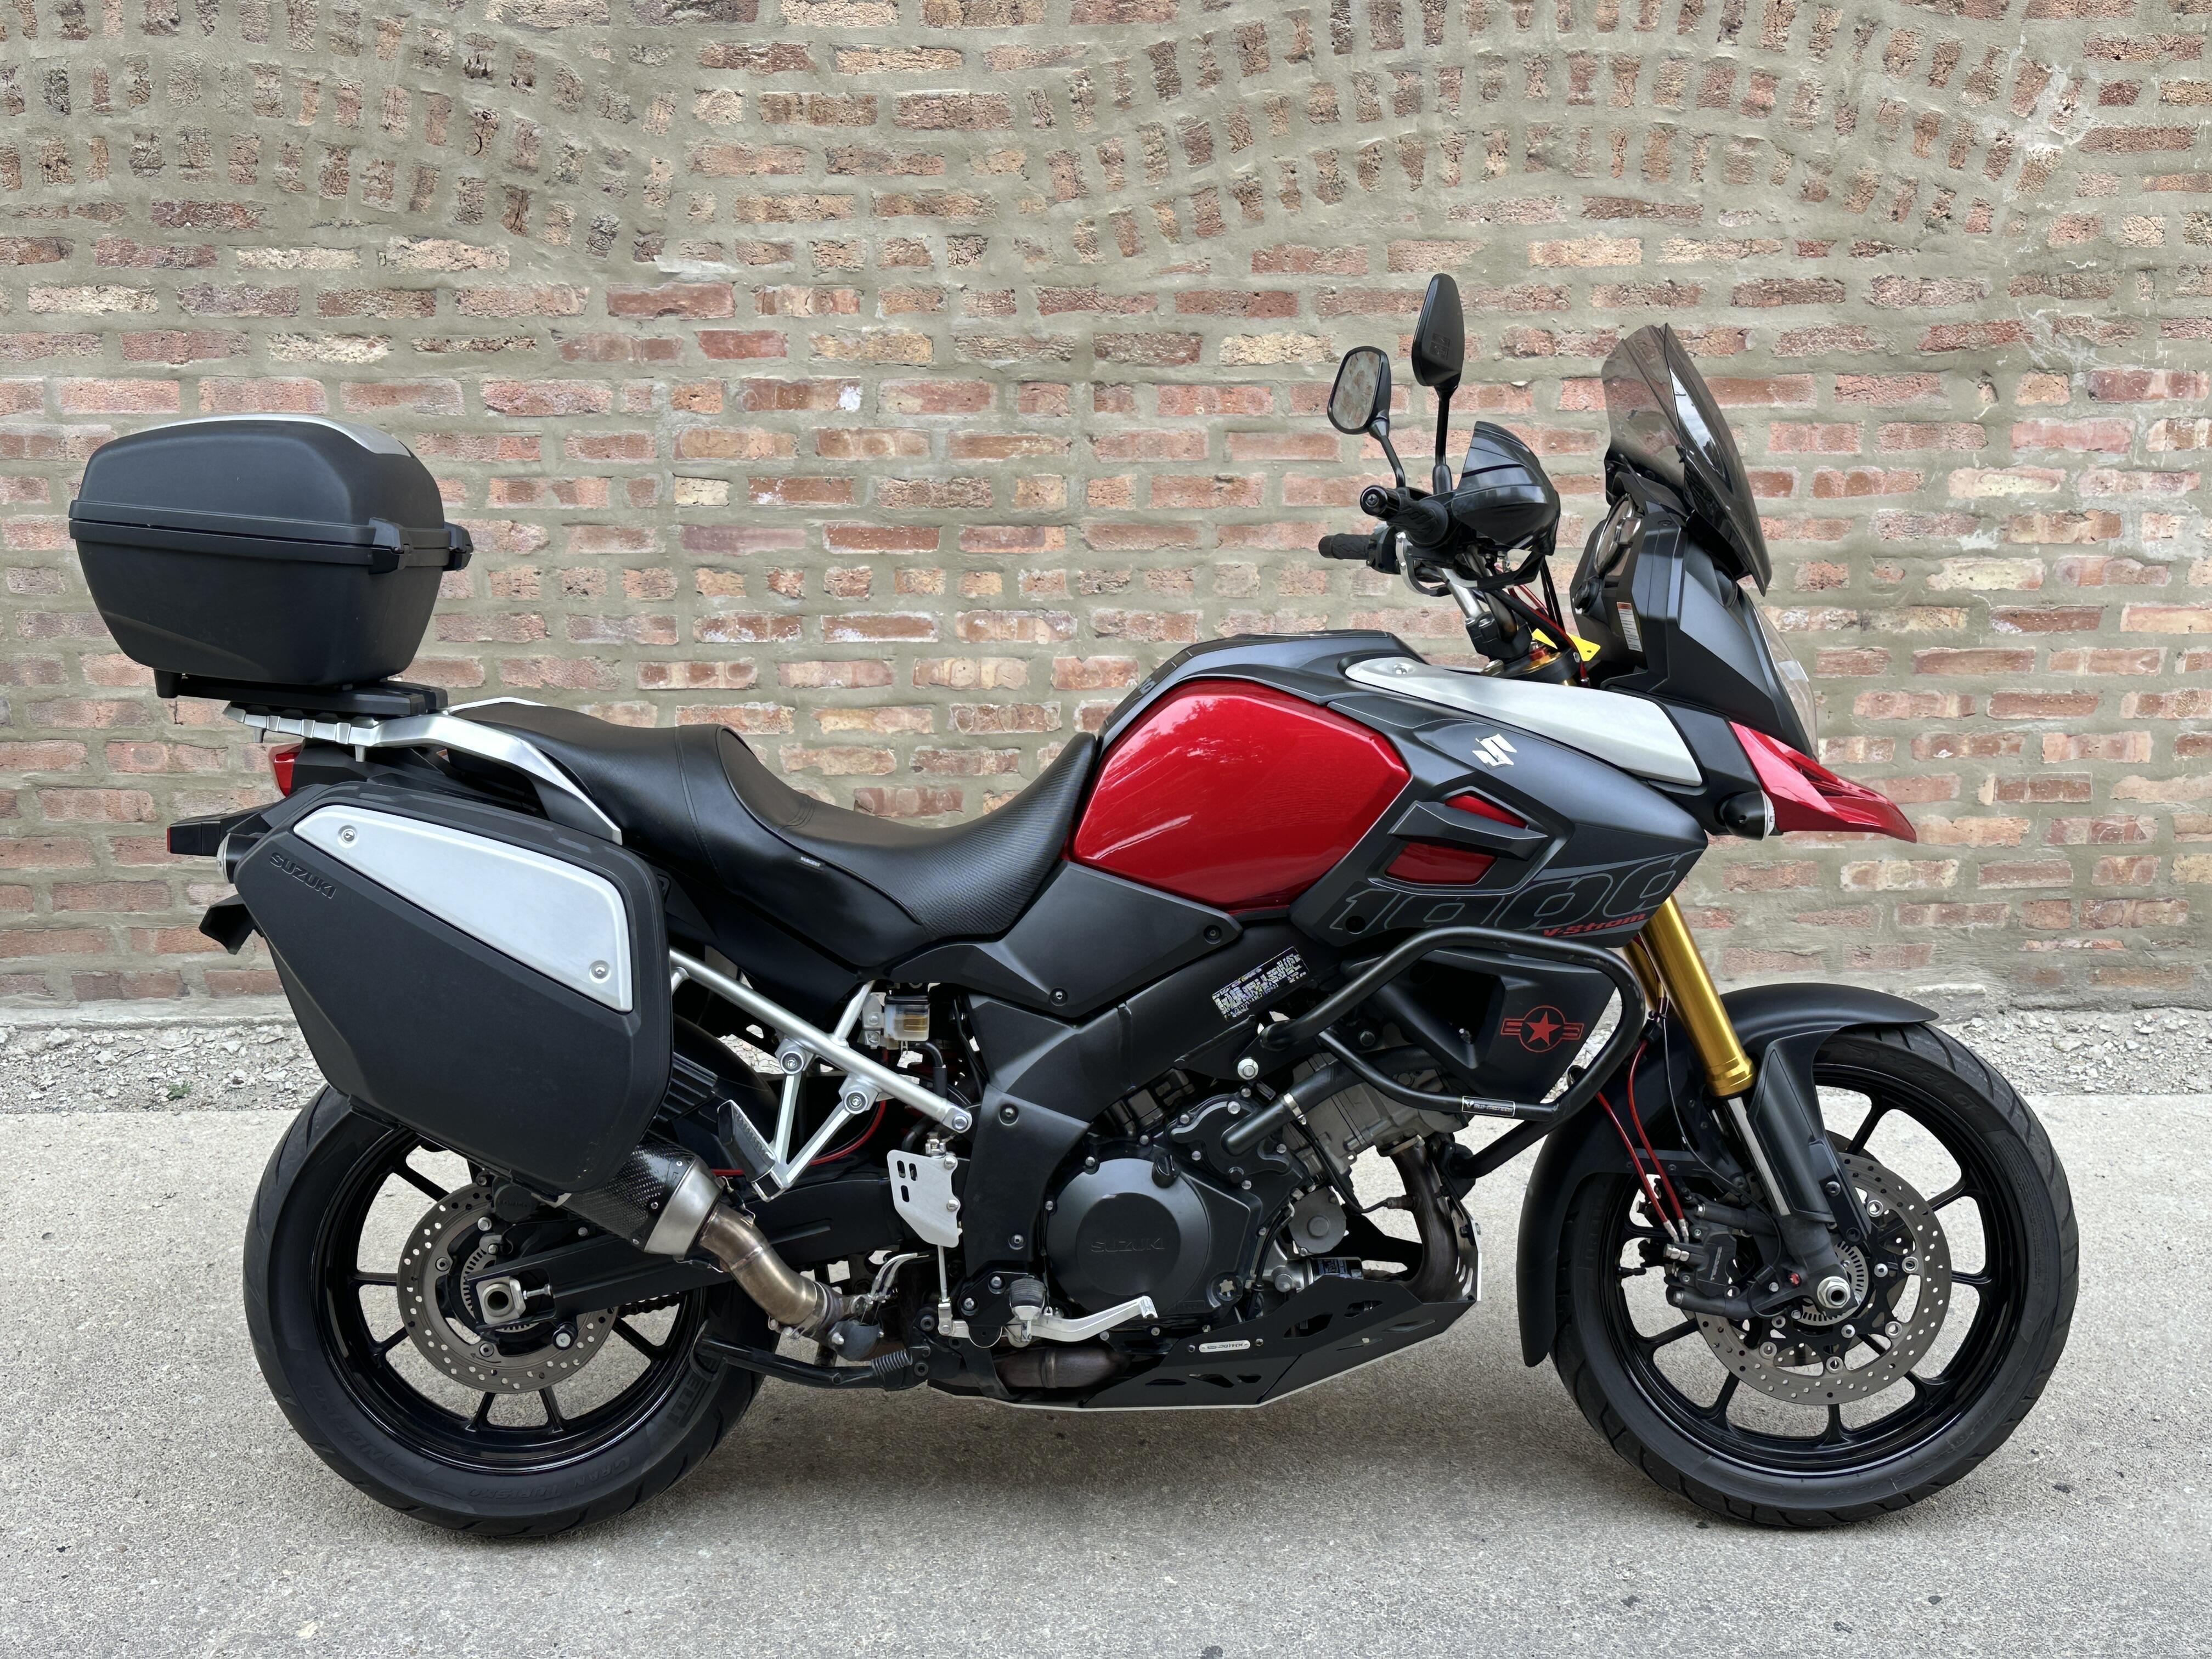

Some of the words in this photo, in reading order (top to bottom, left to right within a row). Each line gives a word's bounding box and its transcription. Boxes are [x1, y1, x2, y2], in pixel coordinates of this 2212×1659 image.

[269, 852, 337, 899] SUZUKI
[1543, 913, 1646, 937] V-Strom
[1090, 1237, 1165, 1252] SUZUKI
[574, 1457, 631, 1488] GRAN
[470, 1485, 562, 1500] TURISMO
